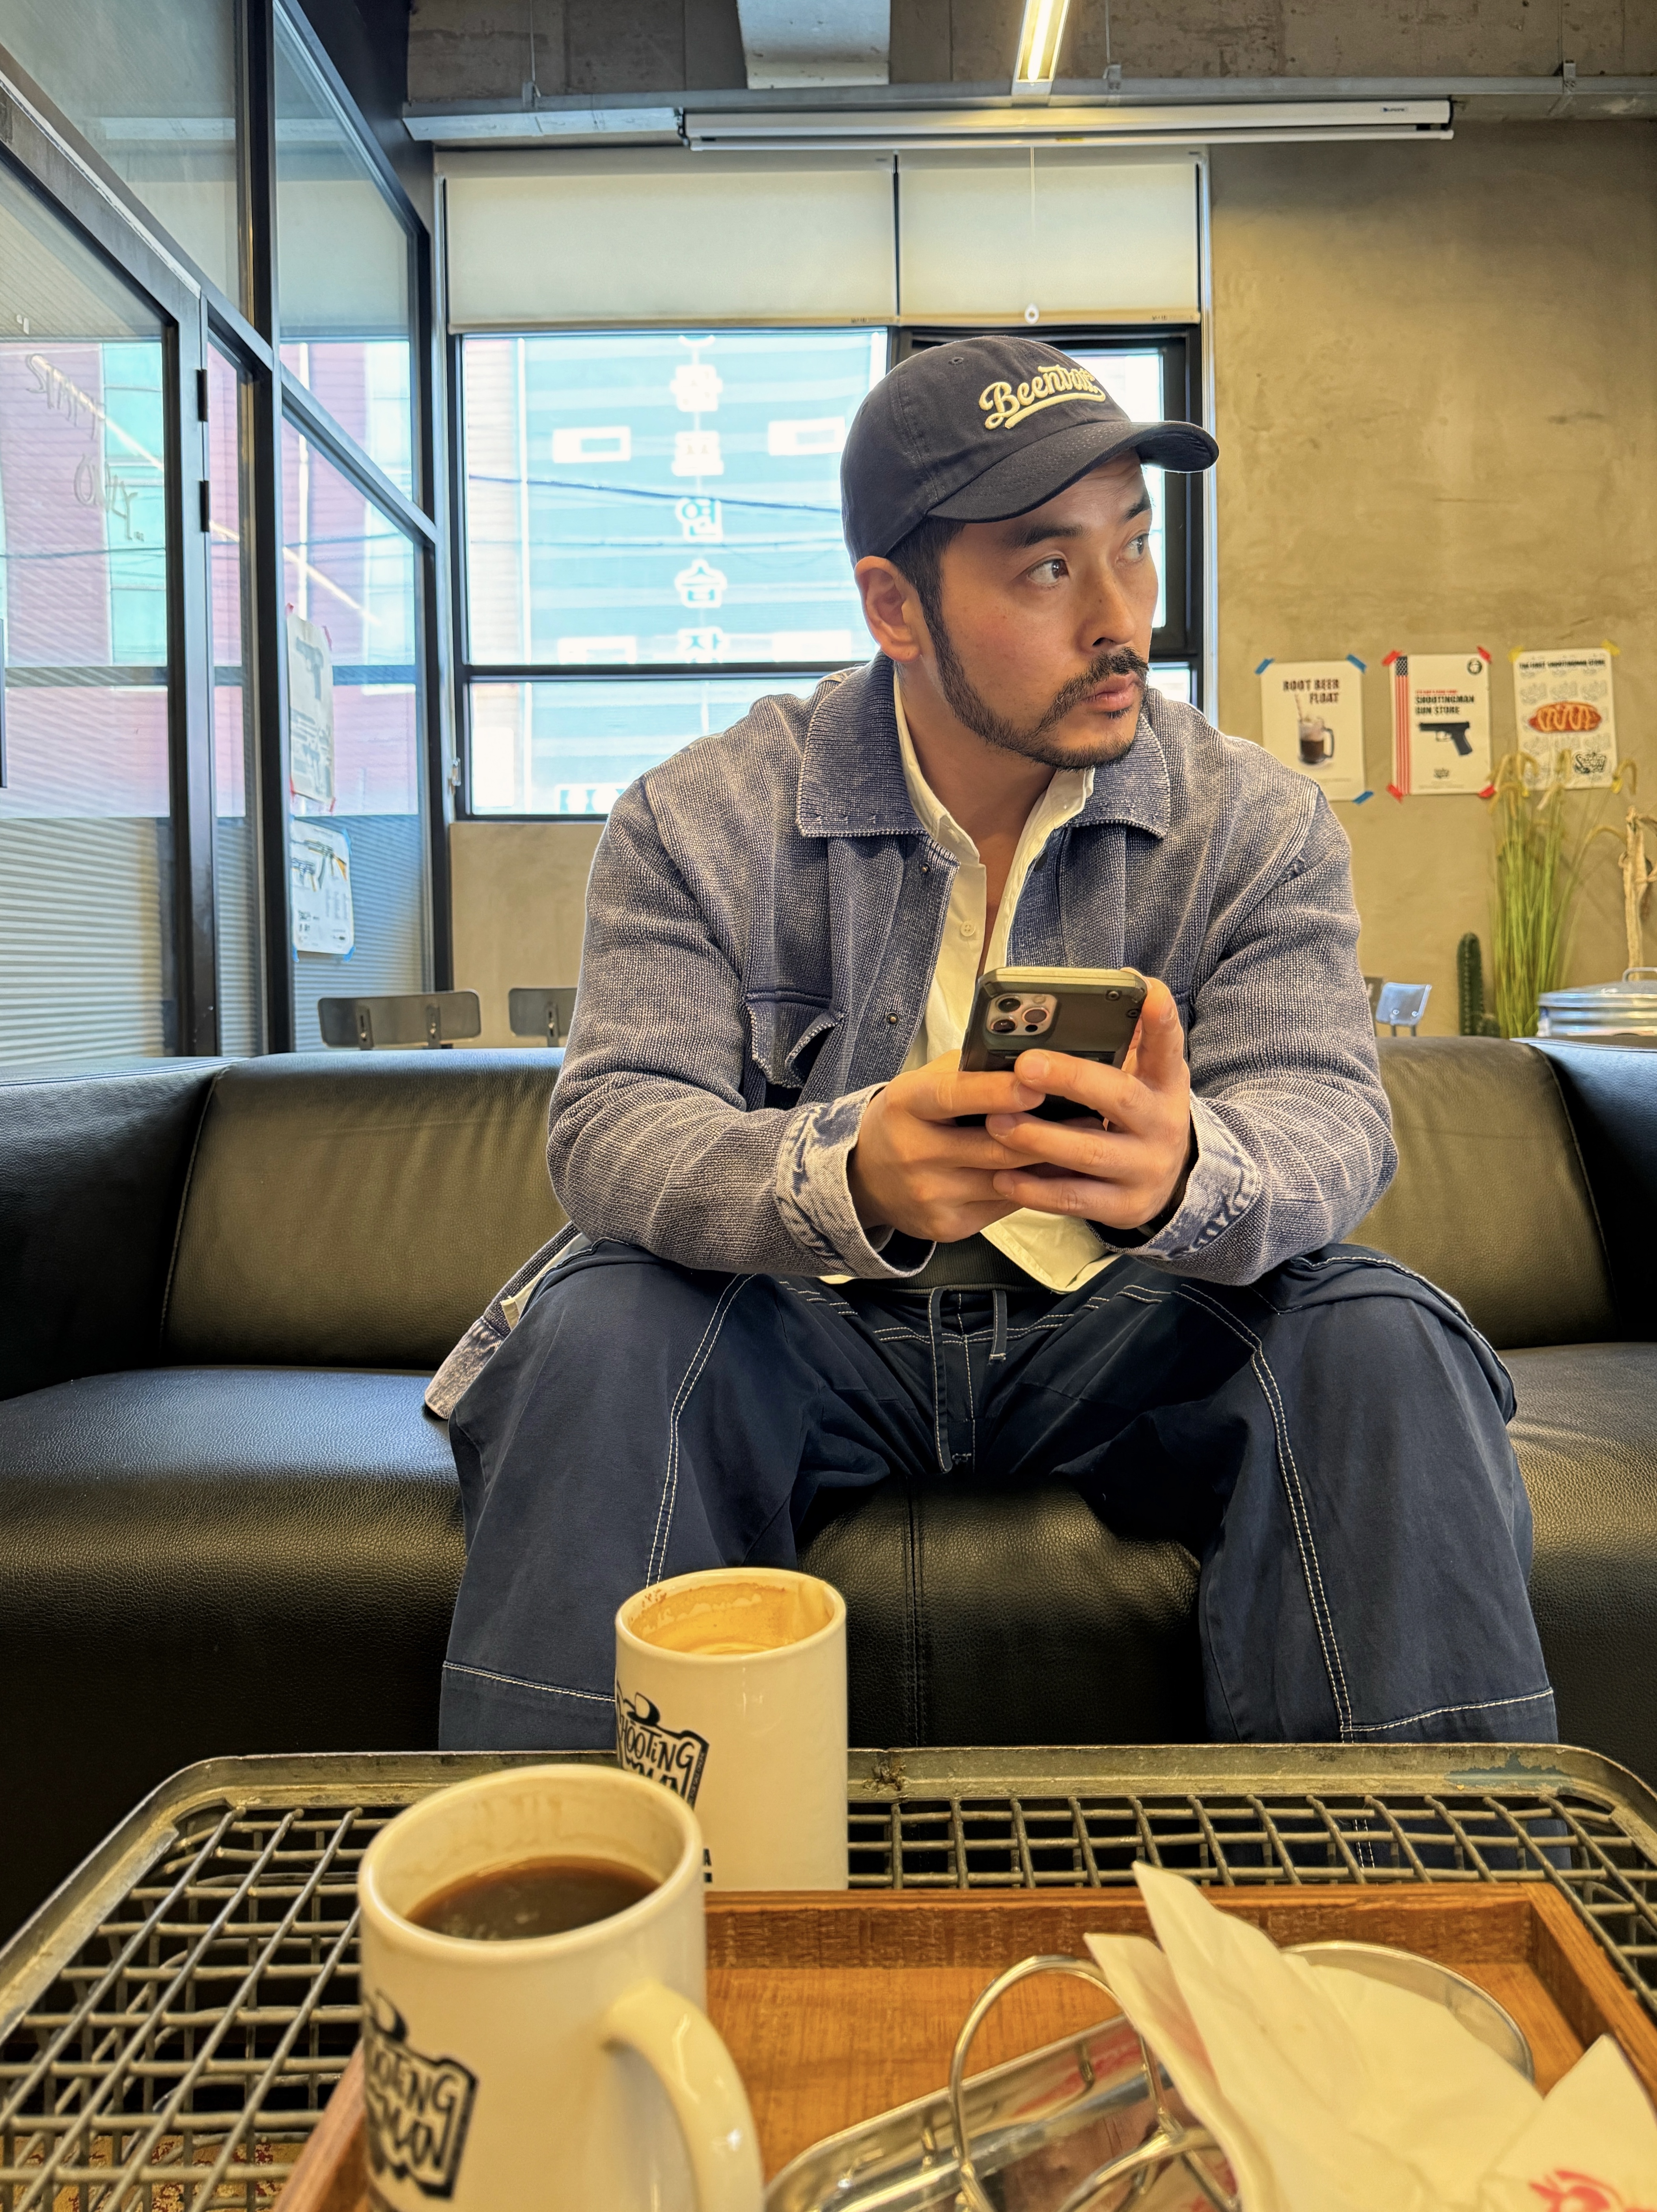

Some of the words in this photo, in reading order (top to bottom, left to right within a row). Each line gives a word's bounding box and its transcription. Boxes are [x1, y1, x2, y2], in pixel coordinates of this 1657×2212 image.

[1284, 680, 1310, 691] ROOT
[1314, 679, 1339, 689] BEER
[1310, 692, 1339, 704] FLOAT
